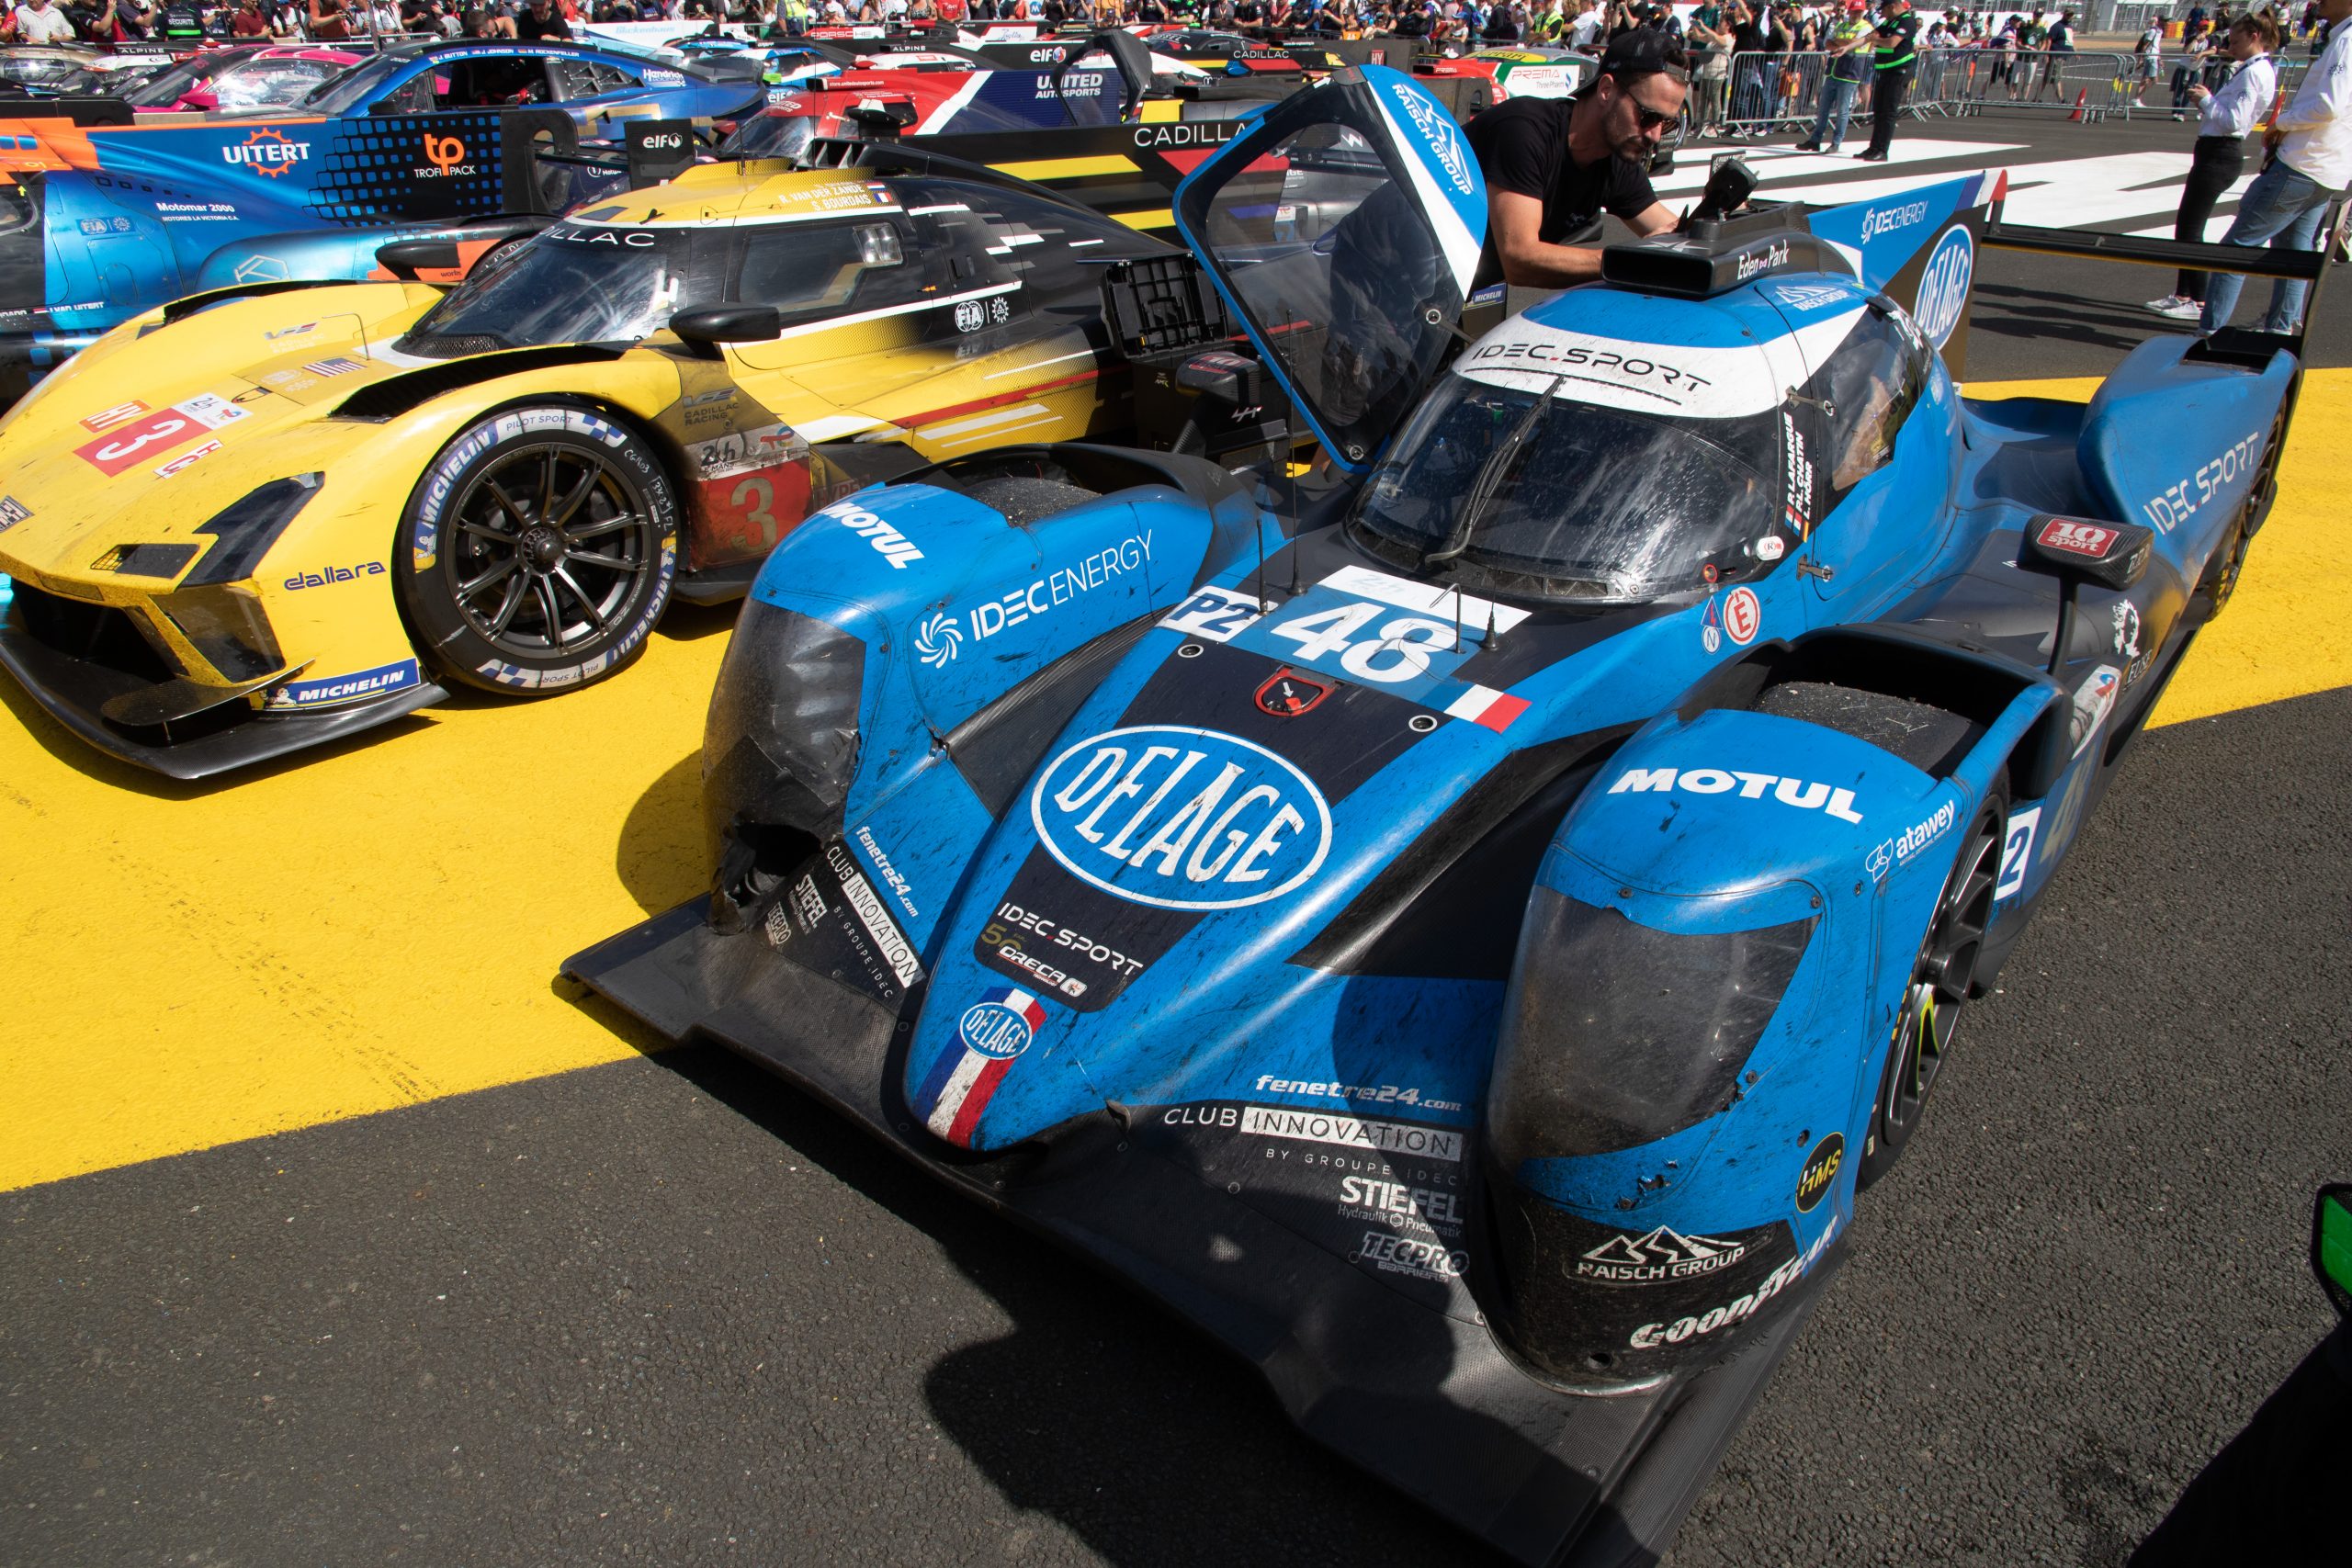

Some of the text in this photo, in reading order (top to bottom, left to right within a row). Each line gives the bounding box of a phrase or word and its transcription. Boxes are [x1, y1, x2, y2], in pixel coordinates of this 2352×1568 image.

[536, 49, 580, 57] ROCKENFELLER
[811, 30, 872, 39] PORSCHE
[445, 51, 468, 60] BUTTON
[1030, 50, 1053, 62] elf
[1233, 51, 1290, 59] CADILLAC
[643, 68, 684, 82] Hendrick
[1035, 88, 1102, 99] AUTSPORTS
[1512, 69, 1560, 80] PREMA
[222, 142, 311, 164] UITERT
[643, 134, 668, 149] elf
[1134, 123, 1246, 148] CADILLA
[1391, 84, 1472, 196] RAISCH GROUP
[156, 202, 235, 212] Motomar 2000
[791, 190, 812, 202] VAN
[812, 187, 831, 199] DER
[832, 184, 865, 196] ZANDE
[822, 194, 872, 209] BOURDAIS
[1737, 239, 1790, 280] Eden Park
[1474, 289, 1503, 303] MICHELIN
[506, 414, 573, 431] PILOT SPORT
[684, 402, 741, 419] CADILLAC
[684, 412, 729, 426] RACING
[95, 419, 187, 461] 3
[1783, 412, 1795, 492] LAFARGUE
[421, 427, 492, 530] MICHELIN
[1795, 431, 1804, 488] CHATIN
[1803, 461, 1813, 505] HÖRR
[729, 477, 778, 548] 3
[820, 502, 925, 570] MOTUL
[2046, 534, 2099, 552] sport
[2057, 522, 2107, 543] 10
[283, 561, 386, 591] dallara
[1169, 592, 1261, 635] P2
[1733, 601, 1751, 635] E
[1270, 602, 1457, 683] 48
[1706, 632, 1717, 649] N
[298, 669, 405, 702] MICHELIN
[1053, 747, 1306, 884] DELAGE
[1606, 768, 1863, 825] MOTUL
[1895, 798, 1955, 859] atawey
[855, 825, 919, 918] fenetre24.com
[795, 874, 828, 929] STIEFEL
[827, 845, 919, 981] CLUB INNOVATION
[766, 901, 792, 945] TECPRO
[843, 921, 873, 965] GROUPE
[871, 967, 893, 998] IDEC
[999, 944, 1067, 982] ORECA
[966, 1009, 1029, 1055] DELAGE
[1255, 1074, 1463, 1112] fenetre24.com
[1163, 1107, 1453, 1156] CLUB INNOVATION
[1266, 1148, 1457, 1187] BY GROUPE IDEC
[1799, 1148, 1842, 1197] HMS
[1340, 1176, 1464, 1224] STIEFEL
[1338, 1204, 1462, 1239] Hydraulik Pneumatik
[1362, 1231, 1469, 1276] TECPRO
[1577, 1246, 1746, 1280] RAISCH GROUP
